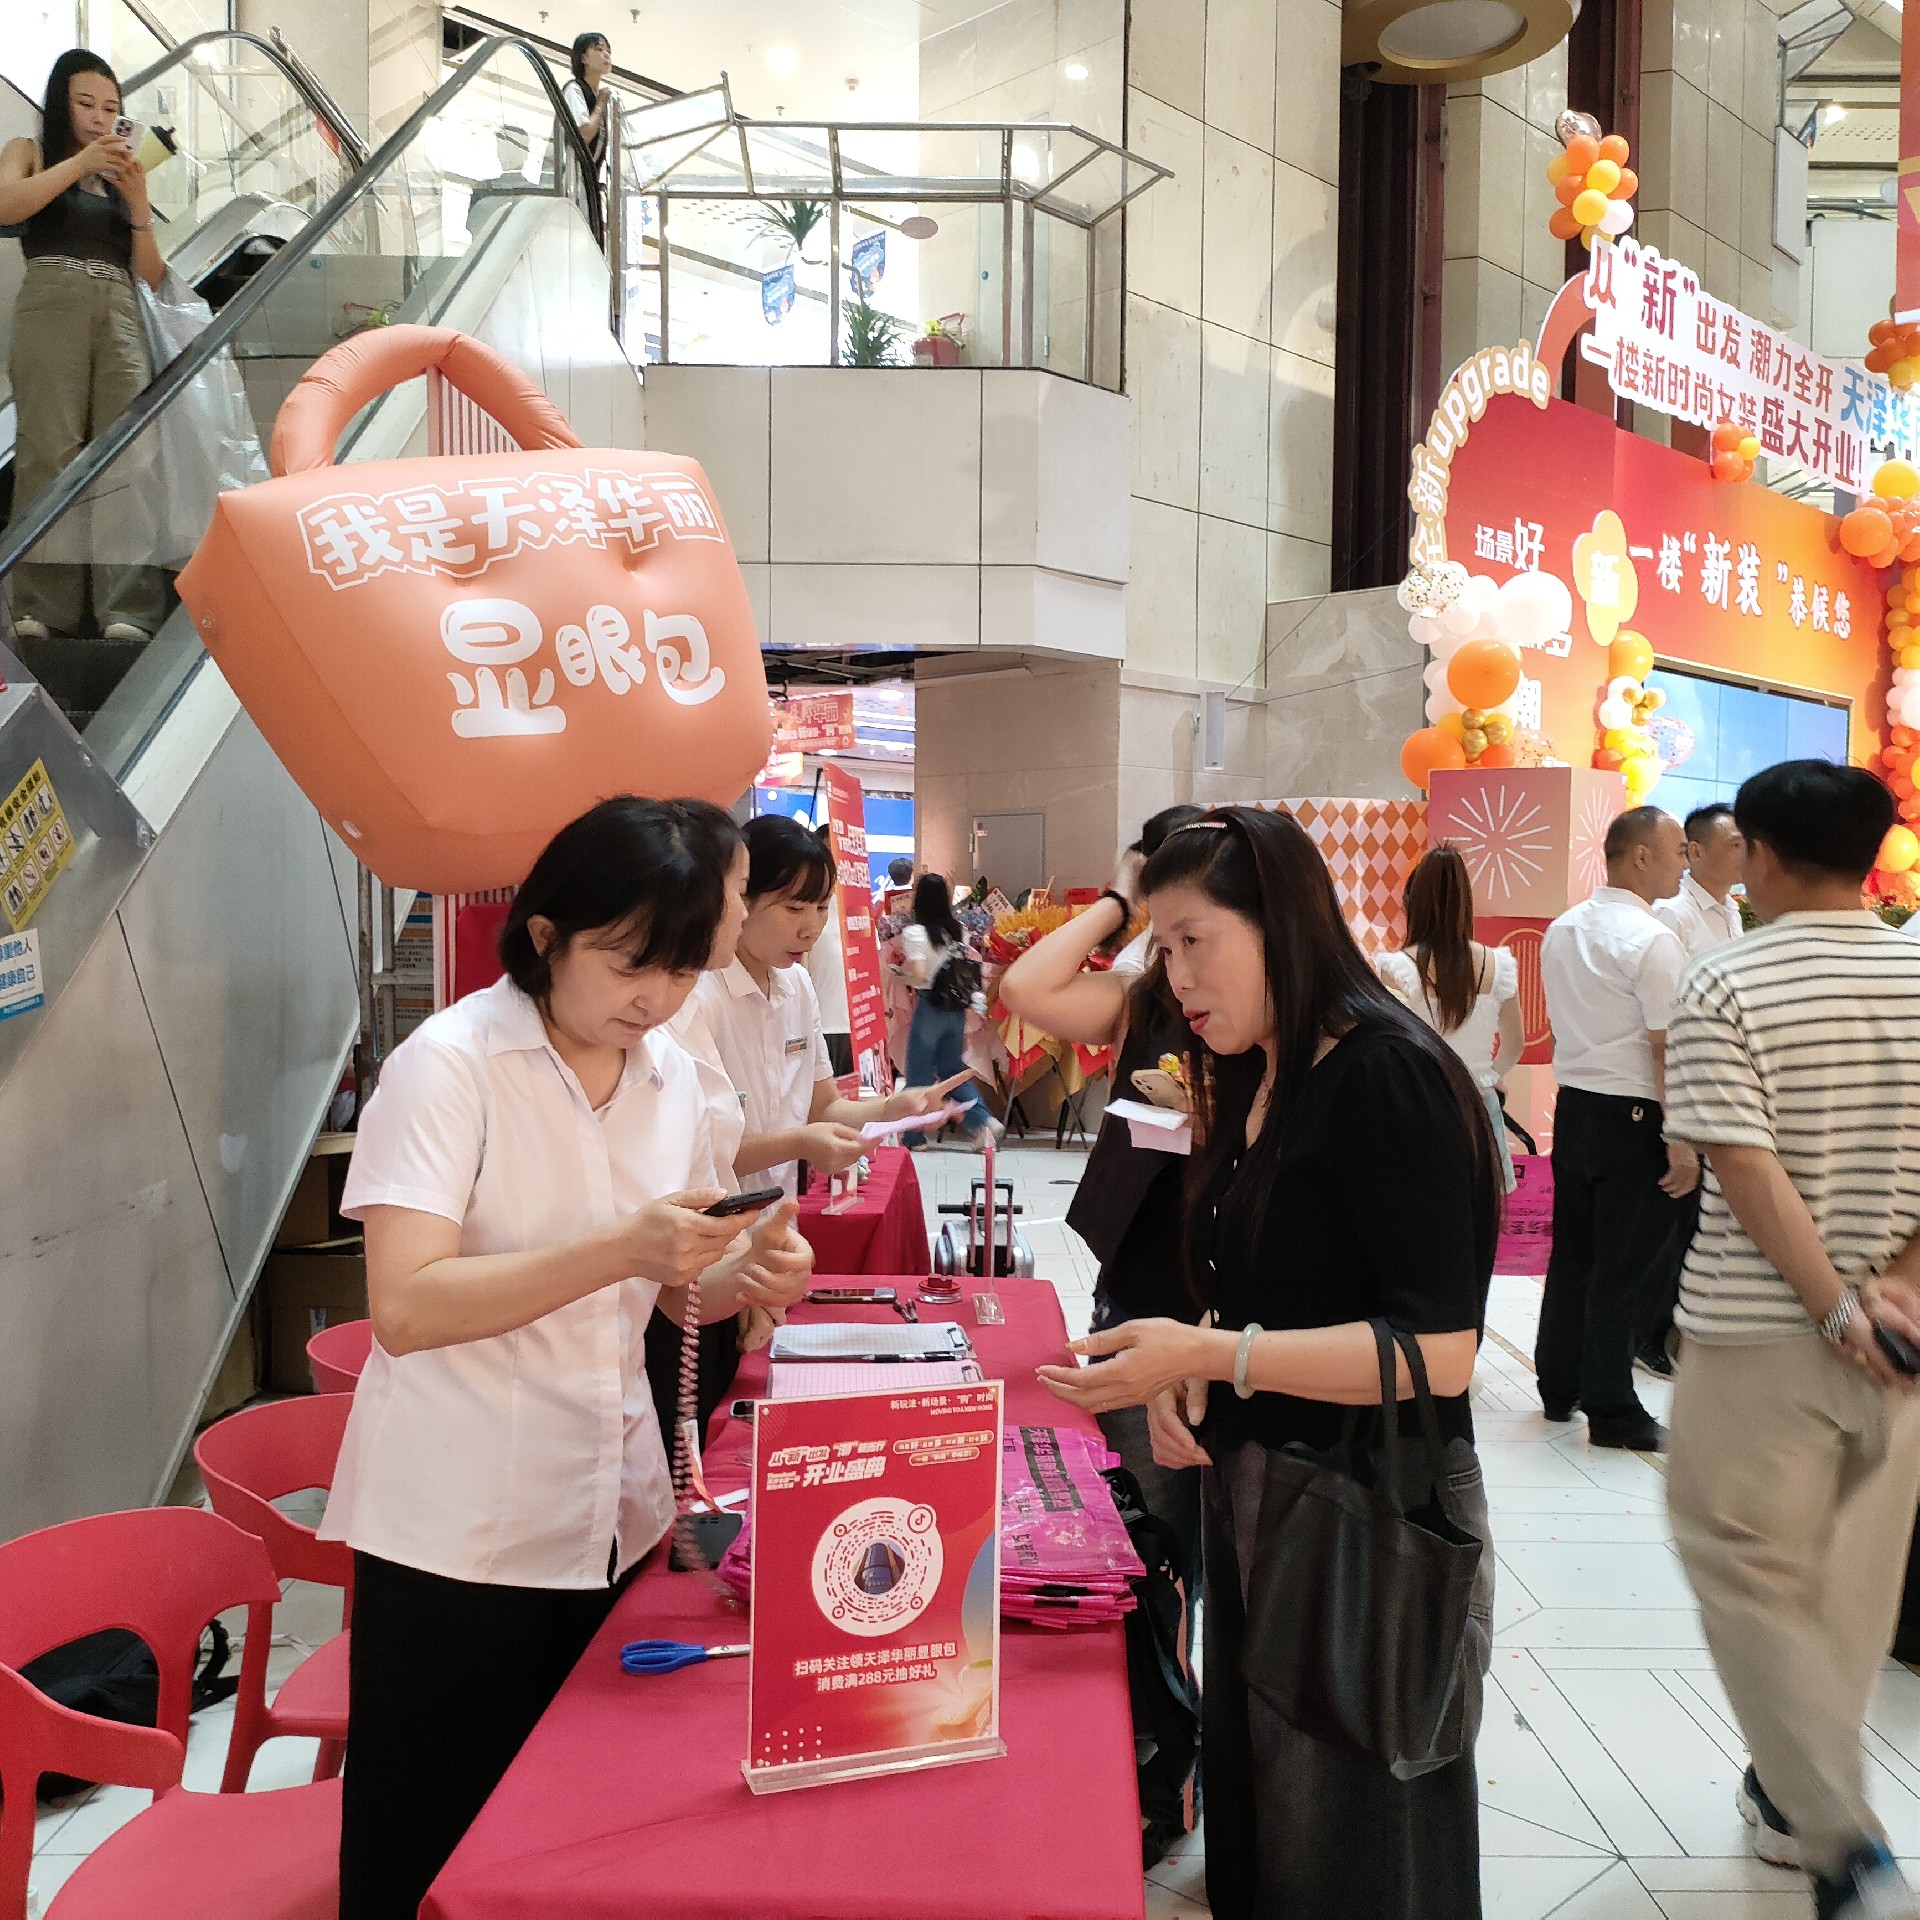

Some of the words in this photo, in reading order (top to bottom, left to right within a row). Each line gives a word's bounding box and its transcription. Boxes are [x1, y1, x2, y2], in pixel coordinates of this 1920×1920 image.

[1431, 347, 1549, 459] upgrade
[1749, 327, 1834, 414] 潮力全开
[1841, 365, 1920, 459] 天泽华
[308, 476, 714, 575] 我是天泽华丽
[1474, 516, 1546, 573] 场景好
[439, 597, 727, 740] 显眼包
[802, 1456, 887, 1488] 开业盛典
[794, 1641, 957, 1677] 扫码关注领天泽华丽显眼包
[816, 1663, 936, 1692] 消费满288元抽好礼
